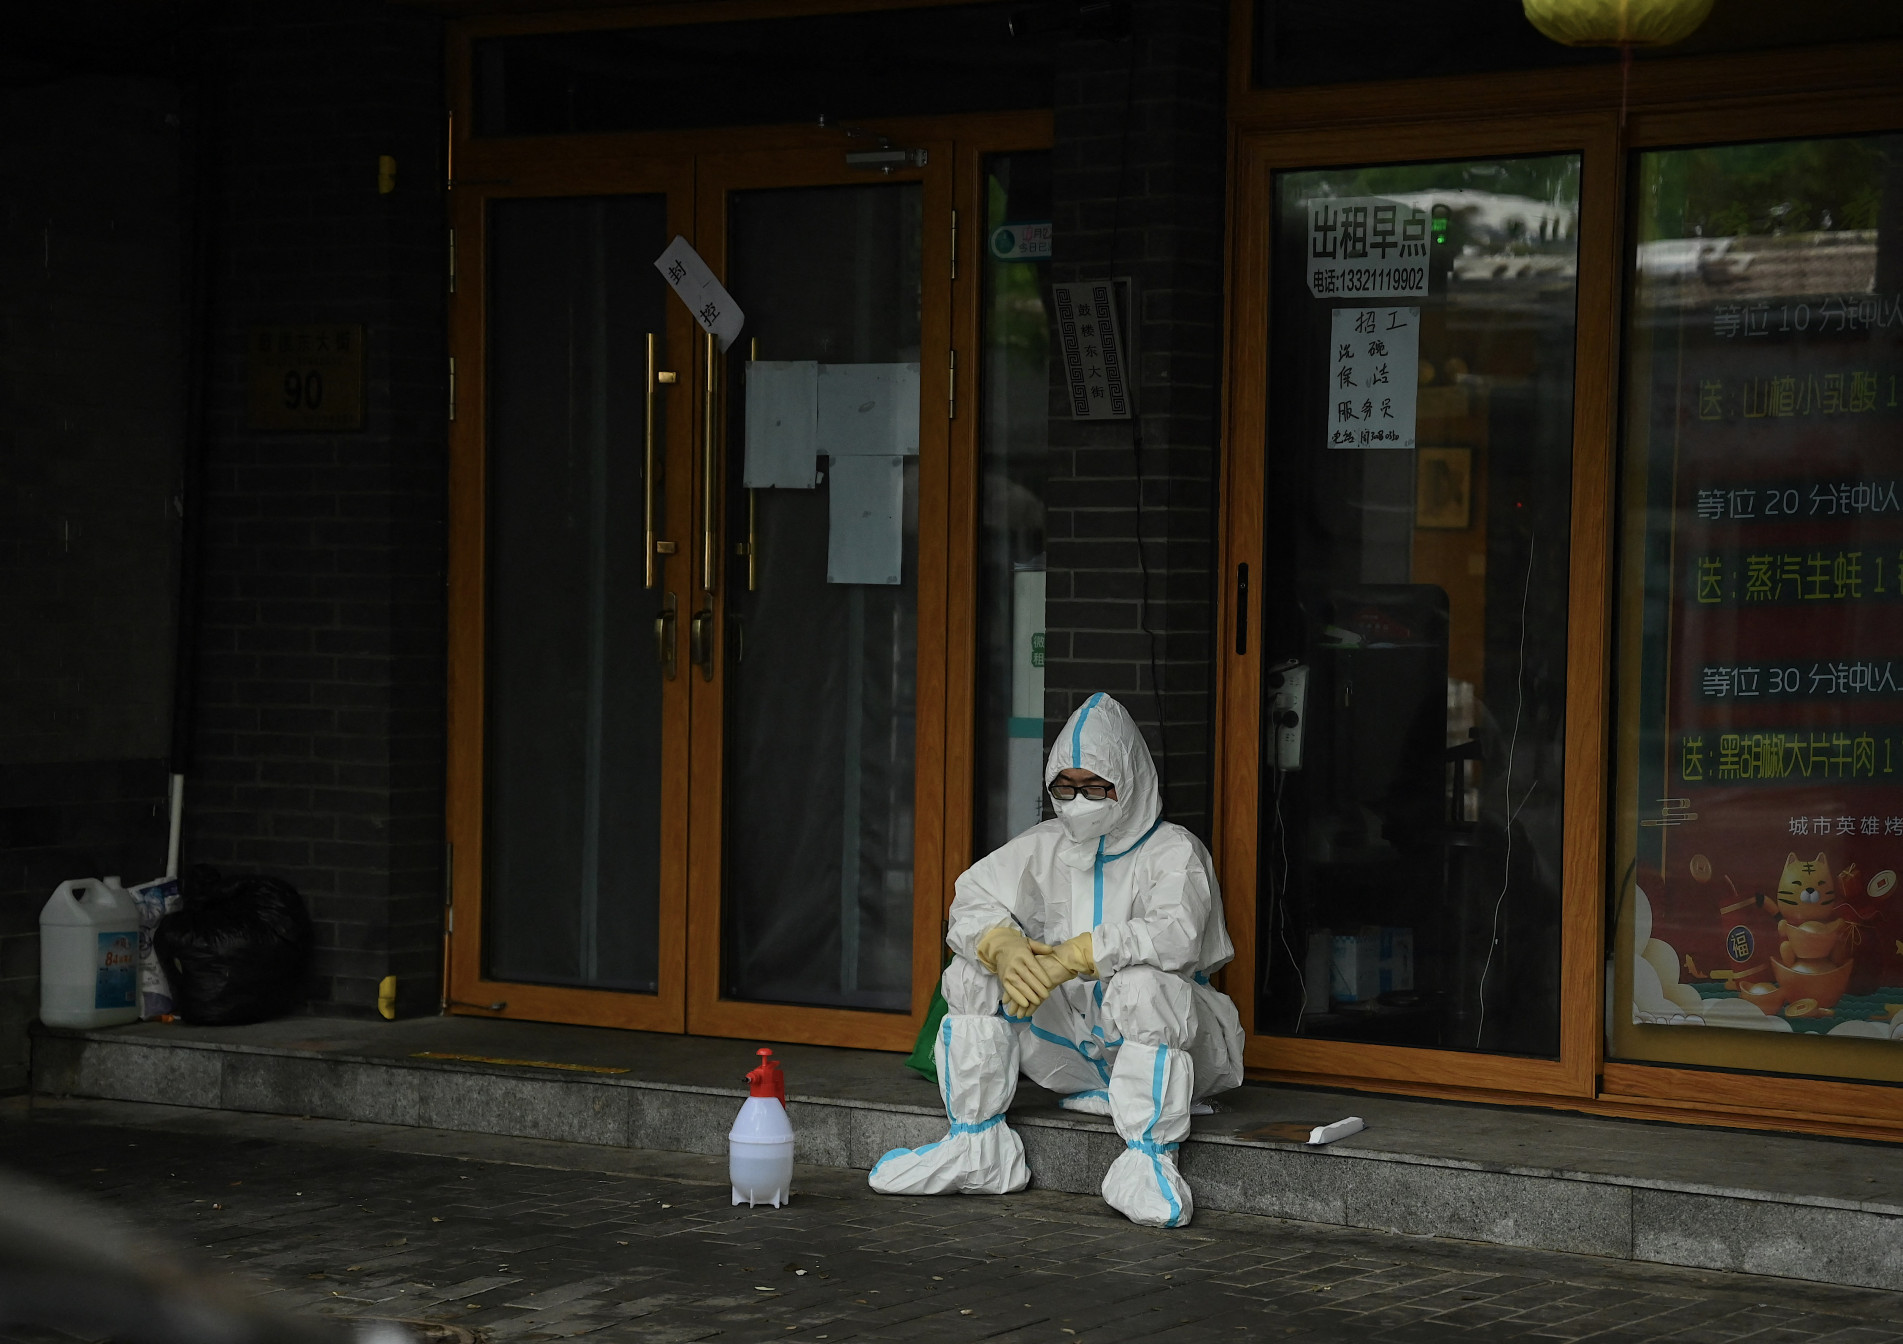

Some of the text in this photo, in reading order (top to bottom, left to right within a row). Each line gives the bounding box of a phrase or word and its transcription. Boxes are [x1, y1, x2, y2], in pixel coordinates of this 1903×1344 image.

[1312, 201, 1427, 260] 出租早点
[1313, 267, 1424, 293] 电话:13321119902
[1354, 311, 1407, 334] 招工
[1713, 303, 1770, 338] 等位
[1778, 304, 1810, 331] 10
[1078, 303, 1104, 398] 鼓楼东大街
[1338, 340, 1388, 362] 洗碗
[284, 370, 322, 410] 90
[1337, 363, 1389, 389] 保洁
[1338, 398, 1394, 423] 服务员
[1697, 488, 1756, 520] 等位
[1764, 489, 1799, 515] 20
[1702, 666, 1760, 697] 等位
[1768, 668, 1800, 693] 30
[1788, 815, 1903, 837] 城市英雄烤
[1730, 931, 1749, 959] 福
